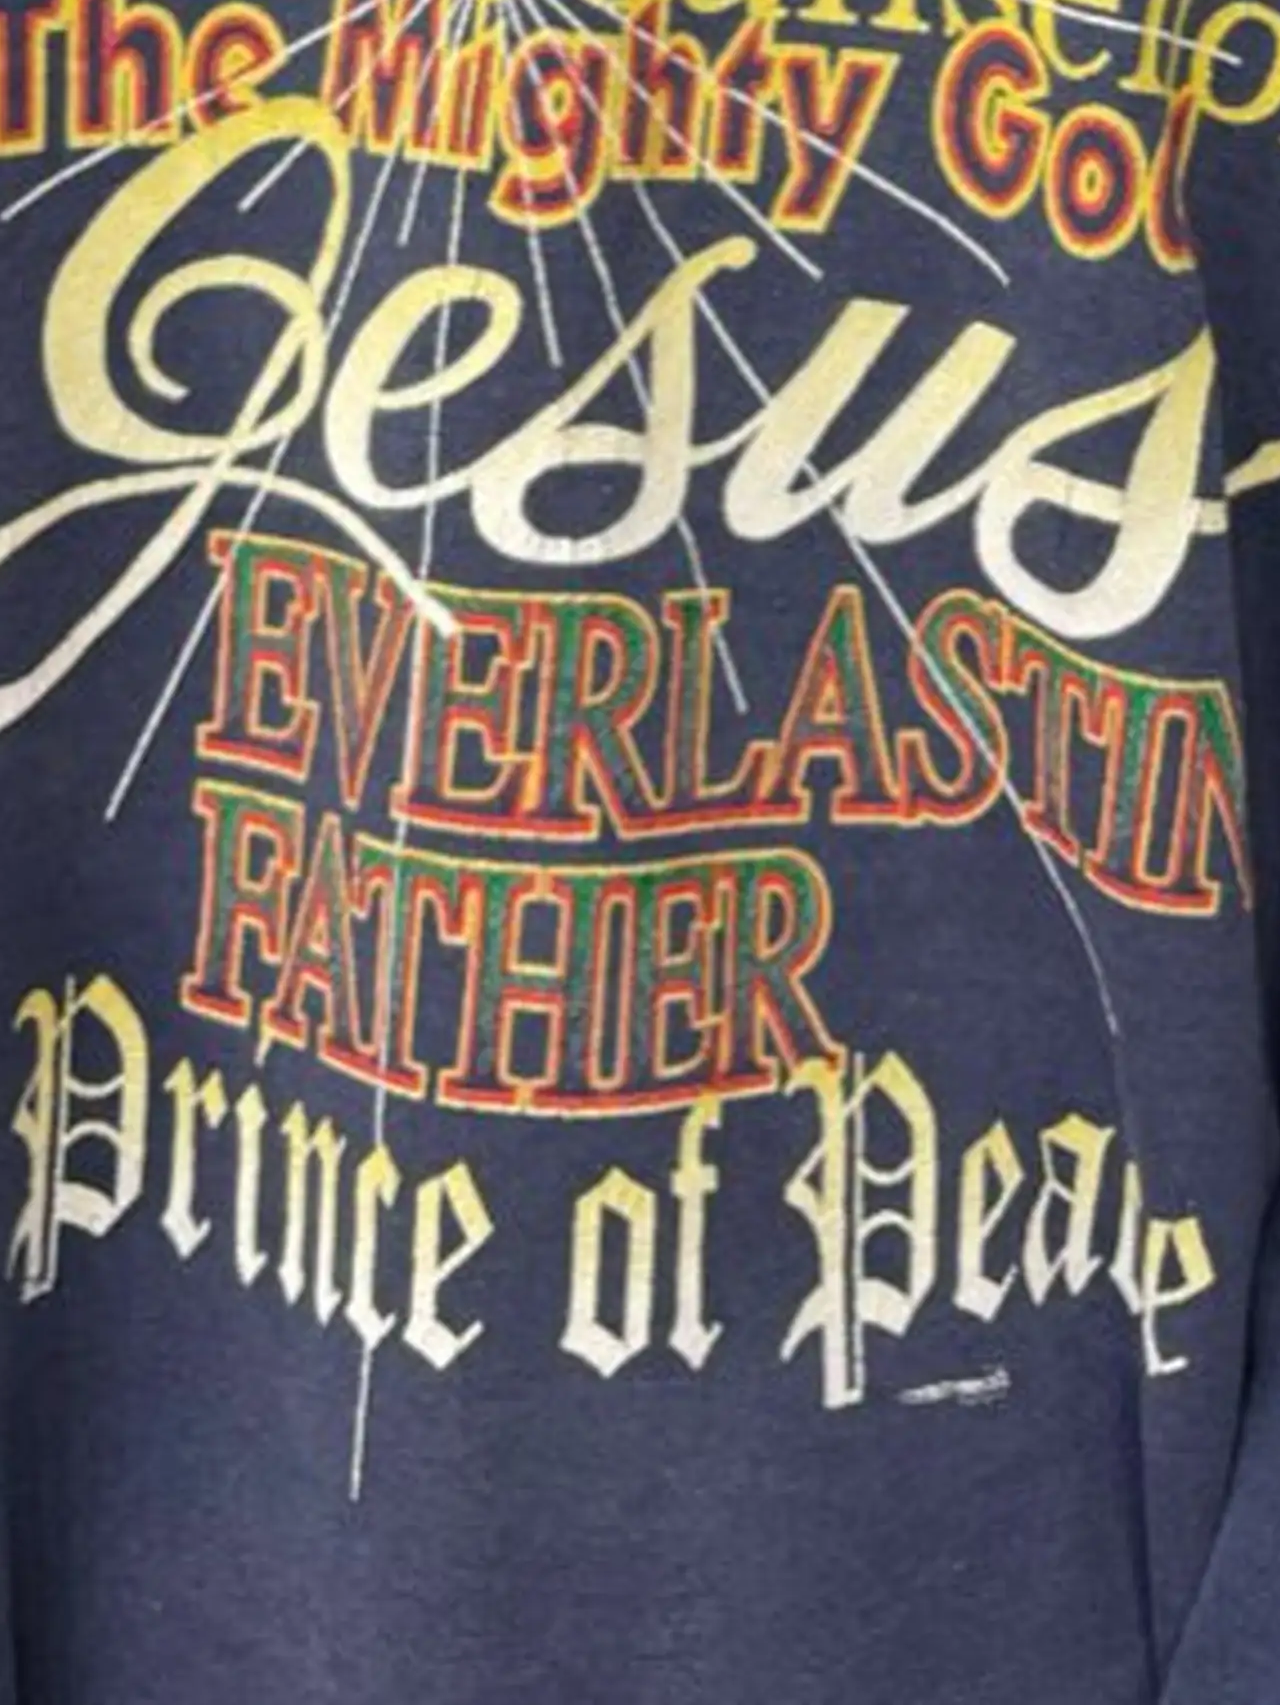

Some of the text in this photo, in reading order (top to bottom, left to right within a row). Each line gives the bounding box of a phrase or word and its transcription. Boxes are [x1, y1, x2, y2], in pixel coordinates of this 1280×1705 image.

[195, 528, 1254, 917] EVERLASTIN
[181, 778, 848, 1118] FATHER
[5, 972, 495, 1370] Prince
[559, 1089, 723, 1379] of
